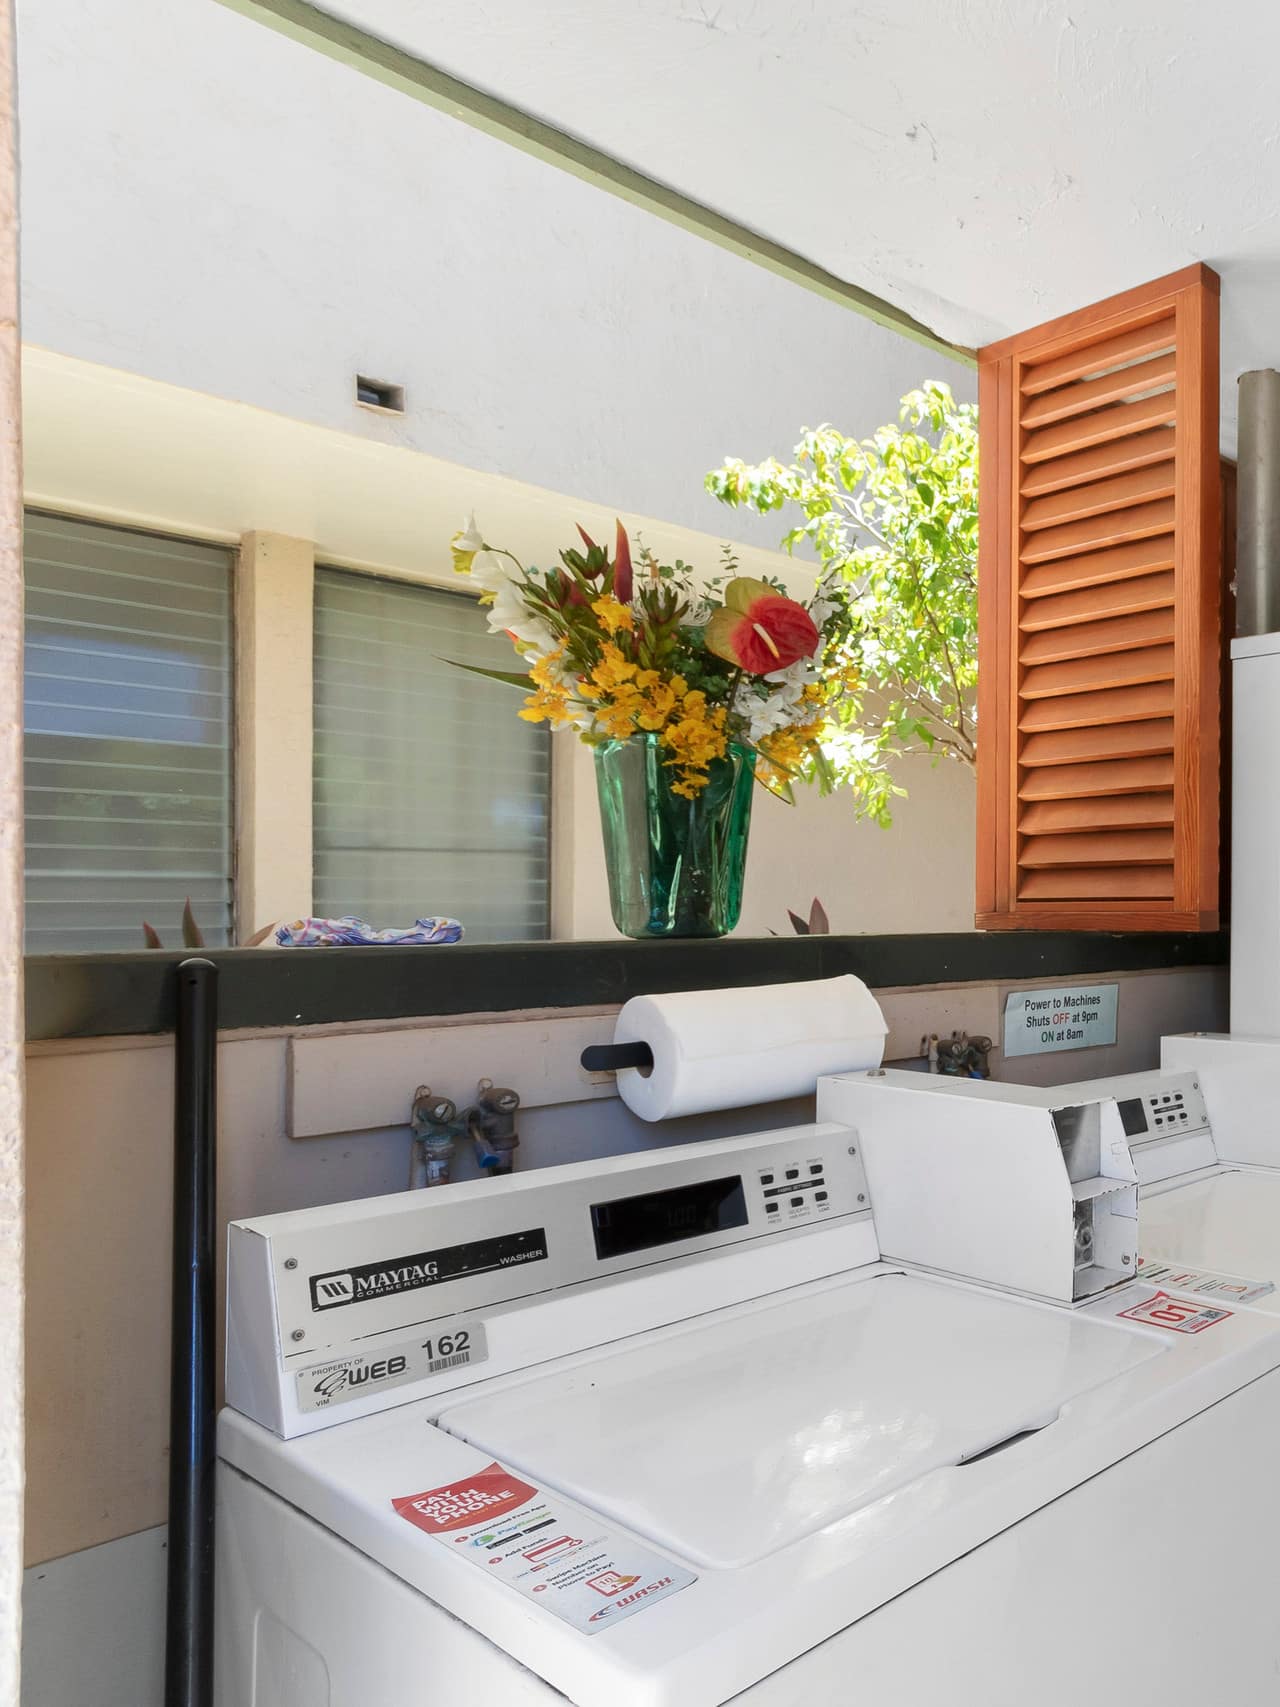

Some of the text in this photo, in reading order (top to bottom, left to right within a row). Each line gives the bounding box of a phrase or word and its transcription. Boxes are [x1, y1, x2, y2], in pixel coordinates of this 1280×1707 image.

[1025, 995, 1101, 1011] Power to Machines
[1026, 1011, 1098, 1028] Shuts OFF at 9pm
[1041, 1029, 1083, 1042] ON at 8am
[500, 1249, 543, 1265] WASHER
[356, 1262, 438, 1292] MAYTAG
[357, 1275, 439, 1297] COMMERCIAL
[1150, 1304, 1199, 1322] 01
[422, 1331, 471, 1360] 162
[312, 1358, 364, 1377] PROPERTY OF
[349, 1356, 406, 1385] WEB
[316, 1399, 330, 1407] VIM
[412, 1490, 452, 1509] PAY
[418, 1489, 479, 1514] WITH
[425, 1492, 490, 1518] YOUR
[434, 1490, 515, 1524] PHONE
[616, 1577, 673, 1608] WASH
